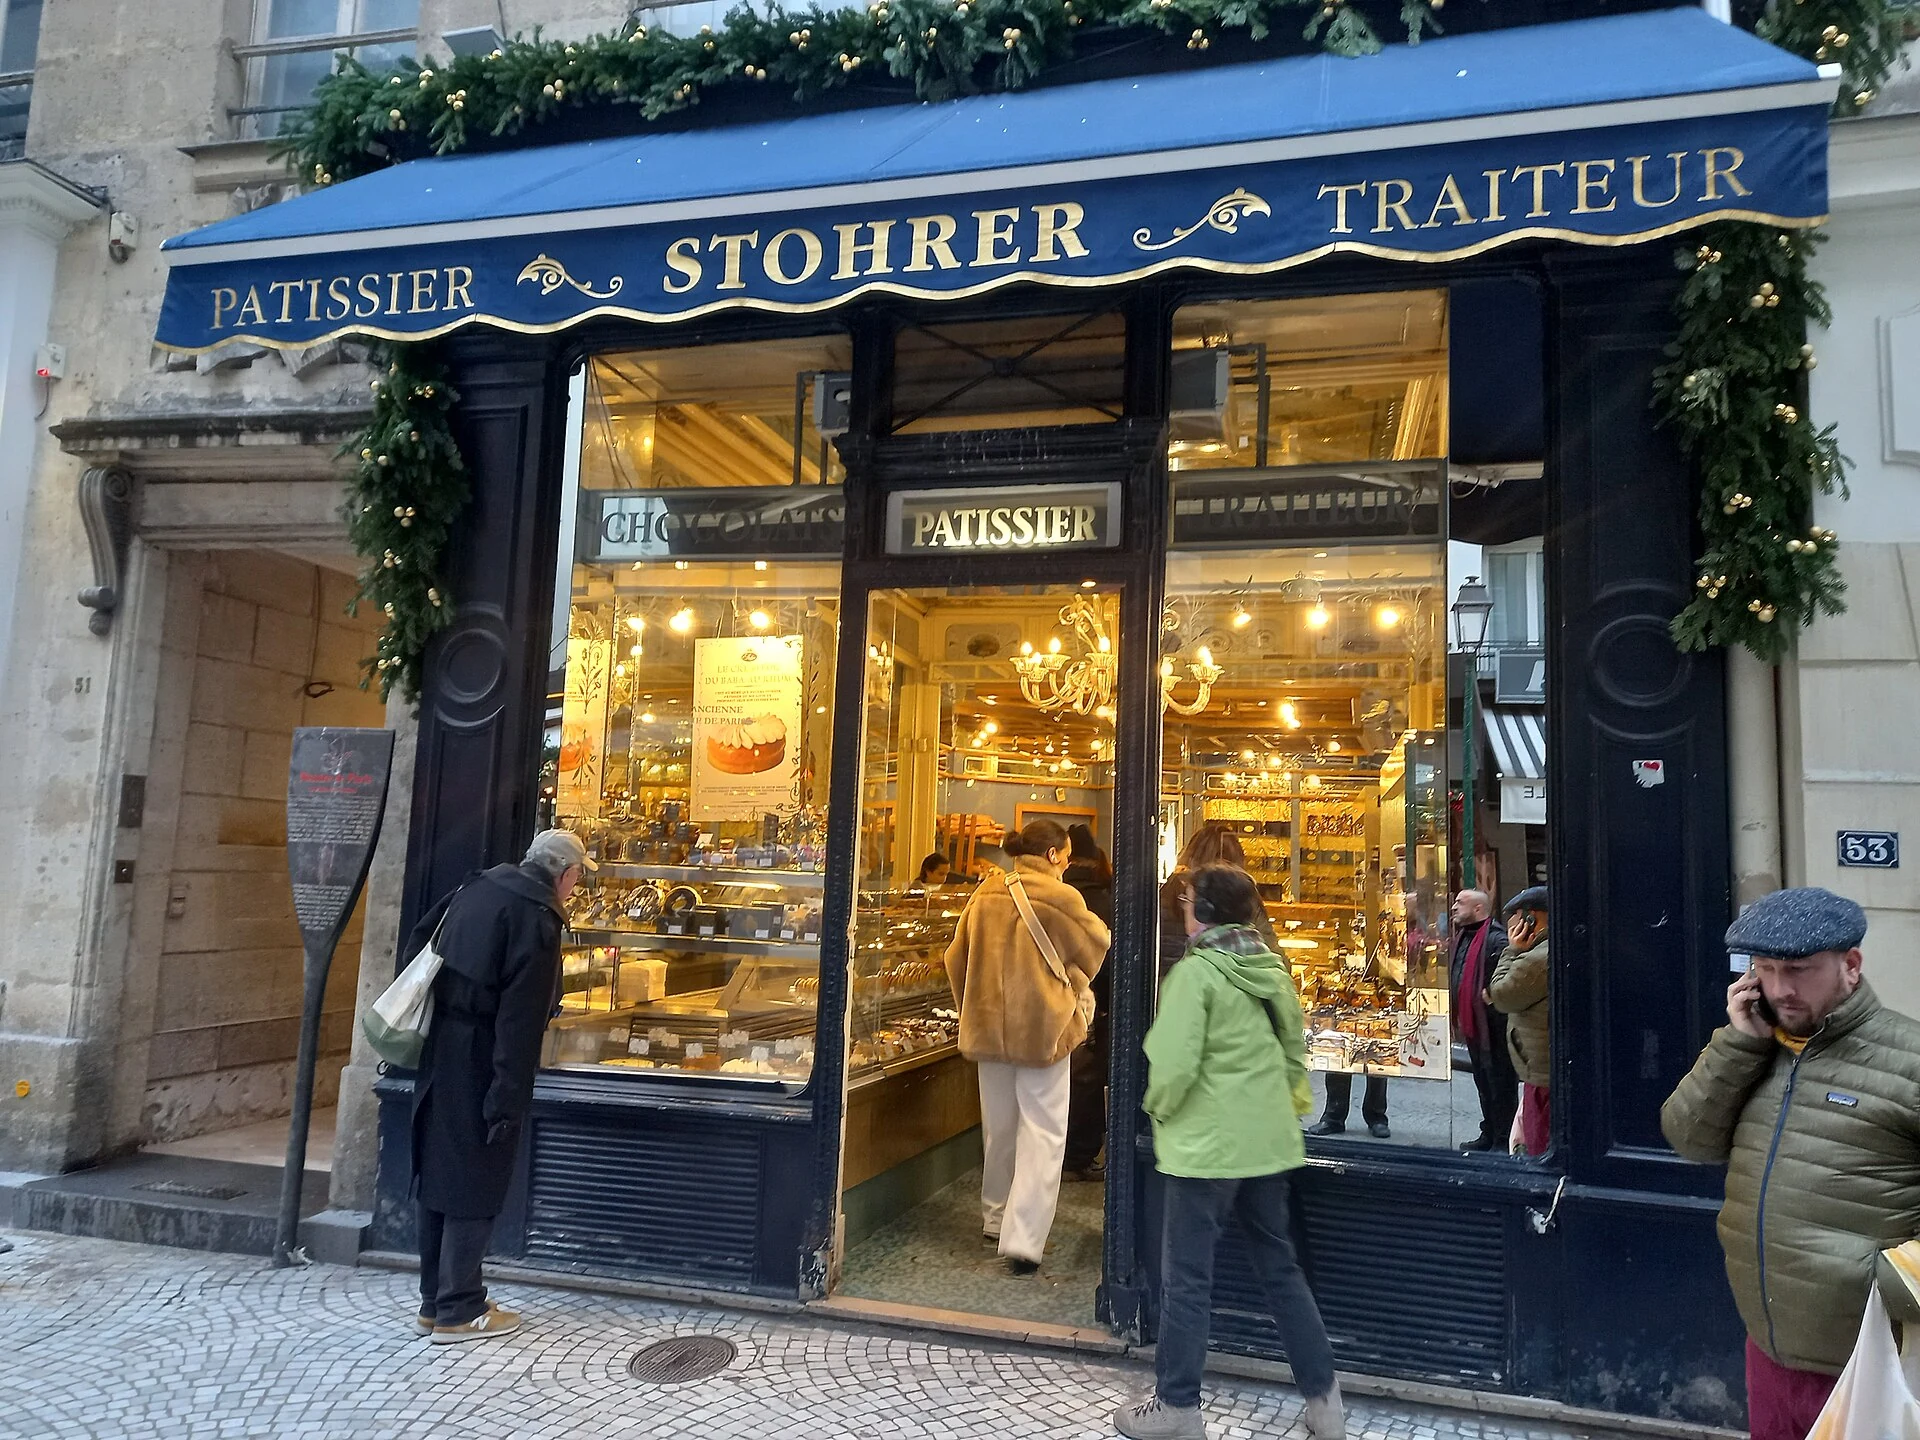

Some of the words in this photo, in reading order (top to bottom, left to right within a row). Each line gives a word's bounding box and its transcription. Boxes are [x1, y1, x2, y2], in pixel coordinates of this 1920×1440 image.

[208, 266, 475, 330] PATISSIER
[663, 202, 1091, 293] STOHRER
[1316, 146, 1754, 235] TRAITEUR
[1196, 487, 1411, 529] TRAITEUR
[602, 507, 840, 544] CHOCOLATS
[911, 505, 1098, 548] PATISSIER
[74, 676, 92, 694] 51
[705, 677, 719, 685] DU
[692, 705, 744, 714] ANCIENNE
[704, 717, 718, 725] DE
[1846, 837, 1888, 862] 53
